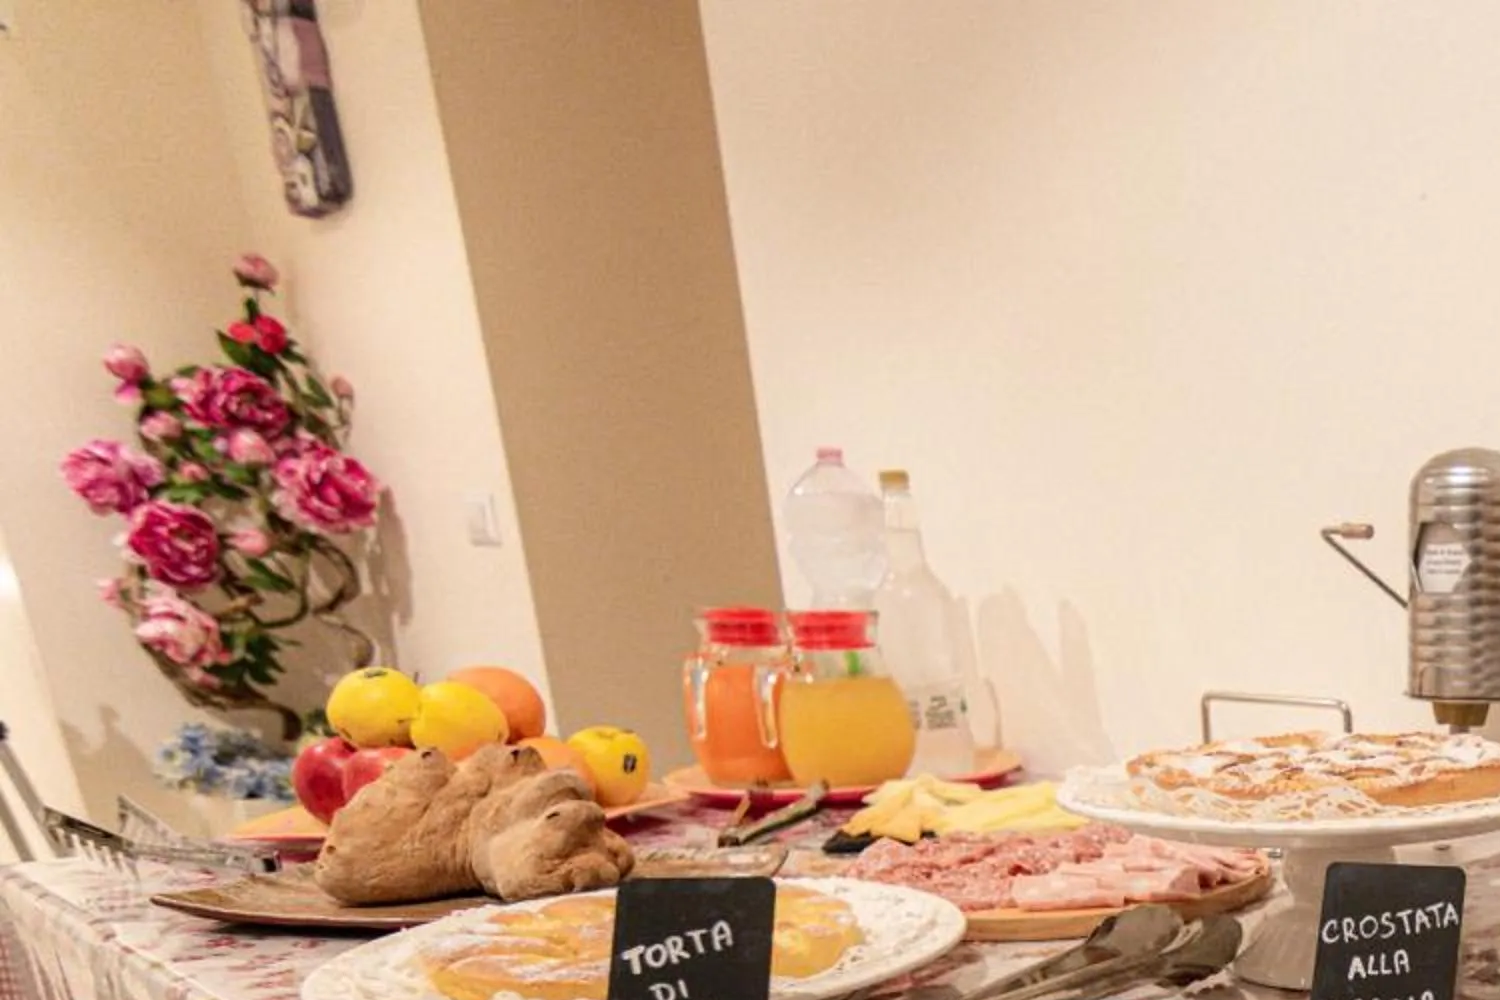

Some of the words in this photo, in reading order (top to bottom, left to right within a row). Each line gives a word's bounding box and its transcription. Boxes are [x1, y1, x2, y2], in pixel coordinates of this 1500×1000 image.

[1321, 902, 1460, 943] CROSTATA
[621, 920, 734, 975] TORTA
[1347, 949, 1411, 981] ALLA
